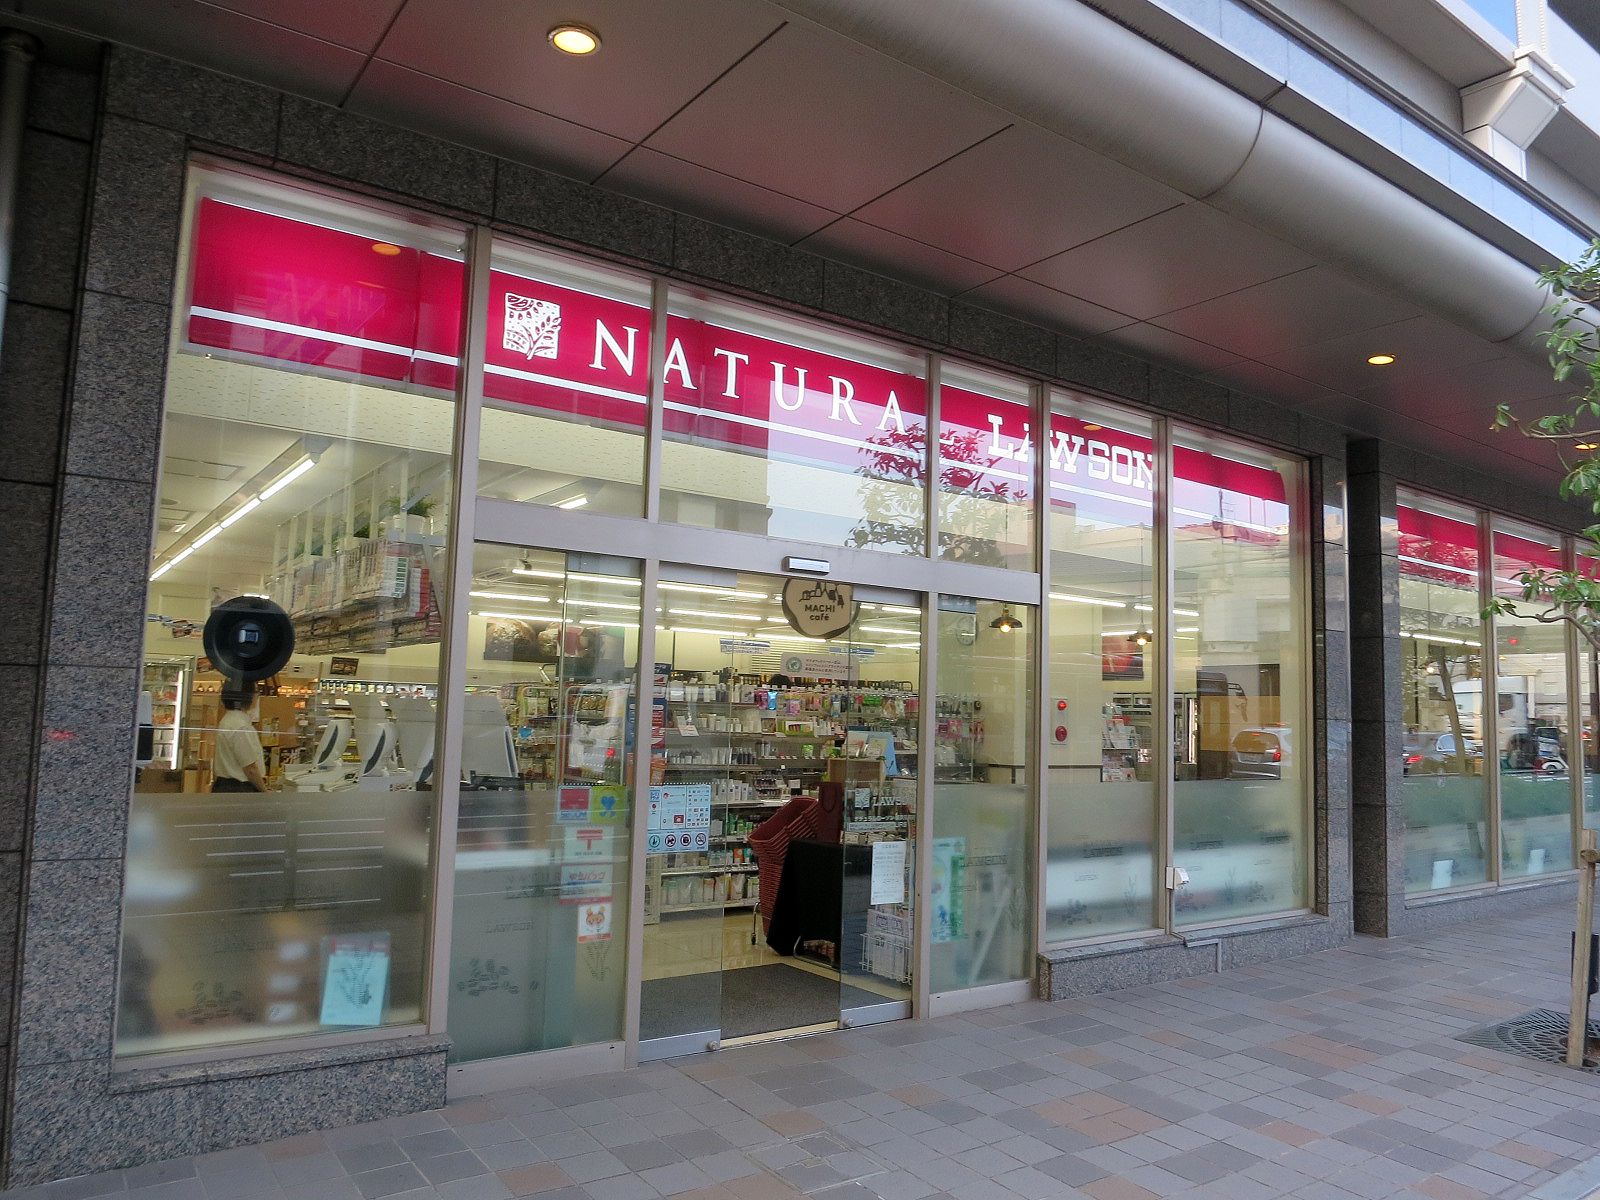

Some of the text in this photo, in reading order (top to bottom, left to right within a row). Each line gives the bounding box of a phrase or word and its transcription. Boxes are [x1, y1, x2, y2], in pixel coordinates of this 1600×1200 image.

[588, 318, 955, 446] NATURA
[804, 604, 836, 613] MACHI
[809, 613, 830, 621] café
